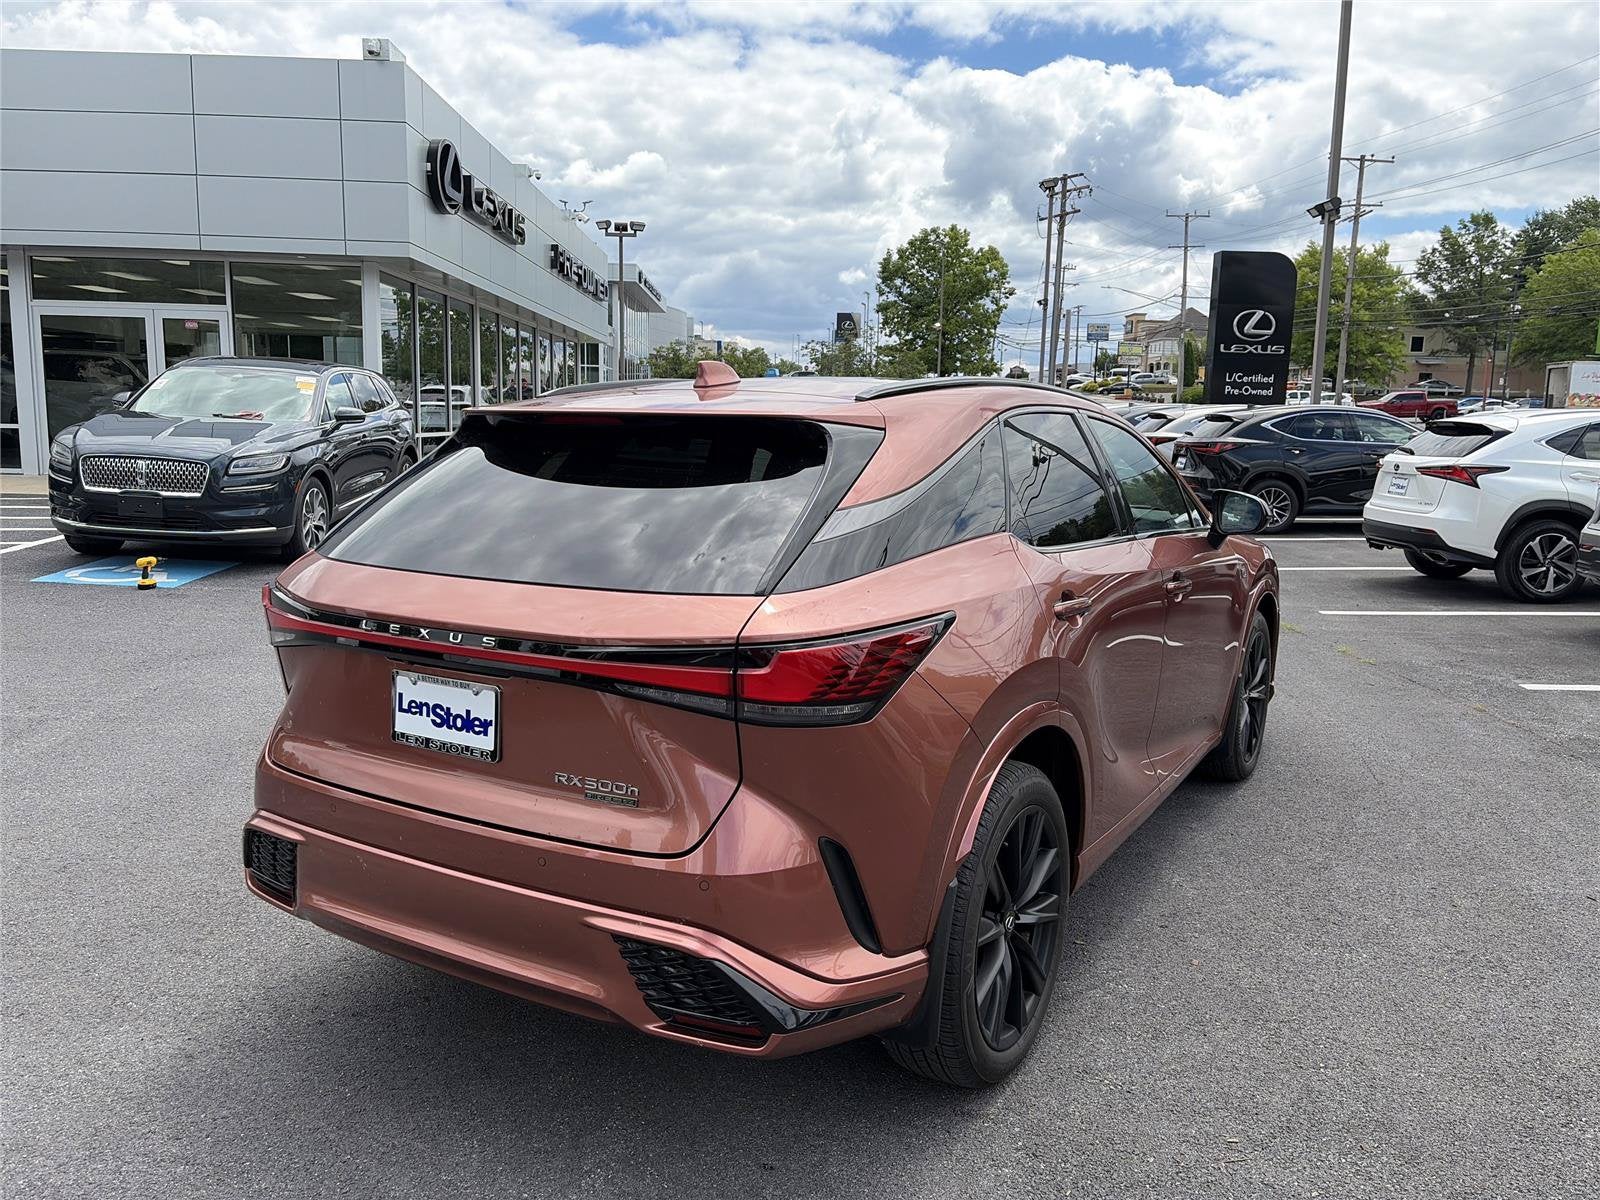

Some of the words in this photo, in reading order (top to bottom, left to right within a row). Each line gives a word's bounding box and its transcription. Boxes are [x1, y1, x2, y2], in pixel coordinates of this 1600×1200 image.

[463, 174, 526, 245] LEXUS
[550, 244, 608, 301] PRE-OWNED
[1220, 344, 1285, 354] LEXUS
[1226, 373, 1274, 383] L/Certified
[1225, 386, 1273, 396] Pre-Owned
[361, 619, 496, 647] LEXUS
[421, 675, 439, 684] BETTER
[451, 680, 459, 688] TO
[396, 733, 427, 747] LEN
[430, 739, 492, 760] STOLER
